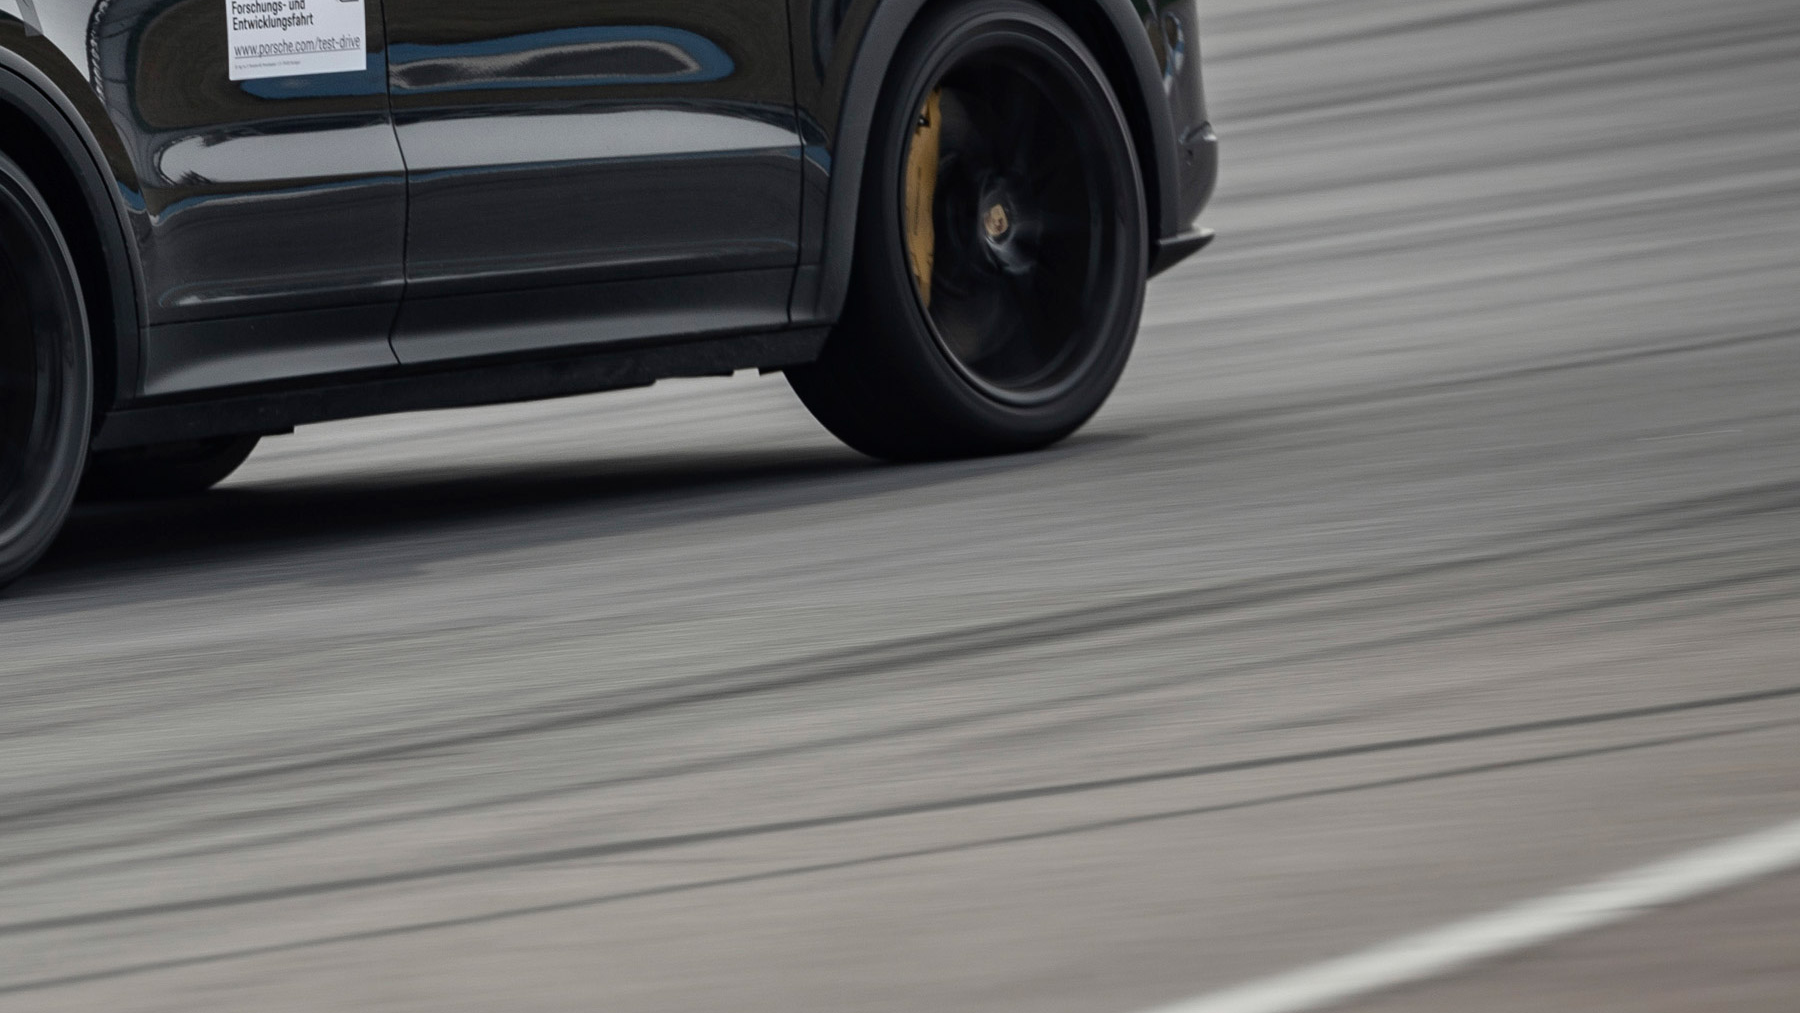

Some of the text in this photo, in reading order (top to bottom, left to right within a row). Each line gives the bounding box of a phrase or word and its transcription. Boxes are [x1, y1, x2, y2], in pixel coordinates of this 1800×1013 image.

[231, 0, 287, 16] Forschungs-
[232, 13, 314, 32] Entwicklungsfahrt
[234, 34, 361, 58] www.porsche.com/test-drive
